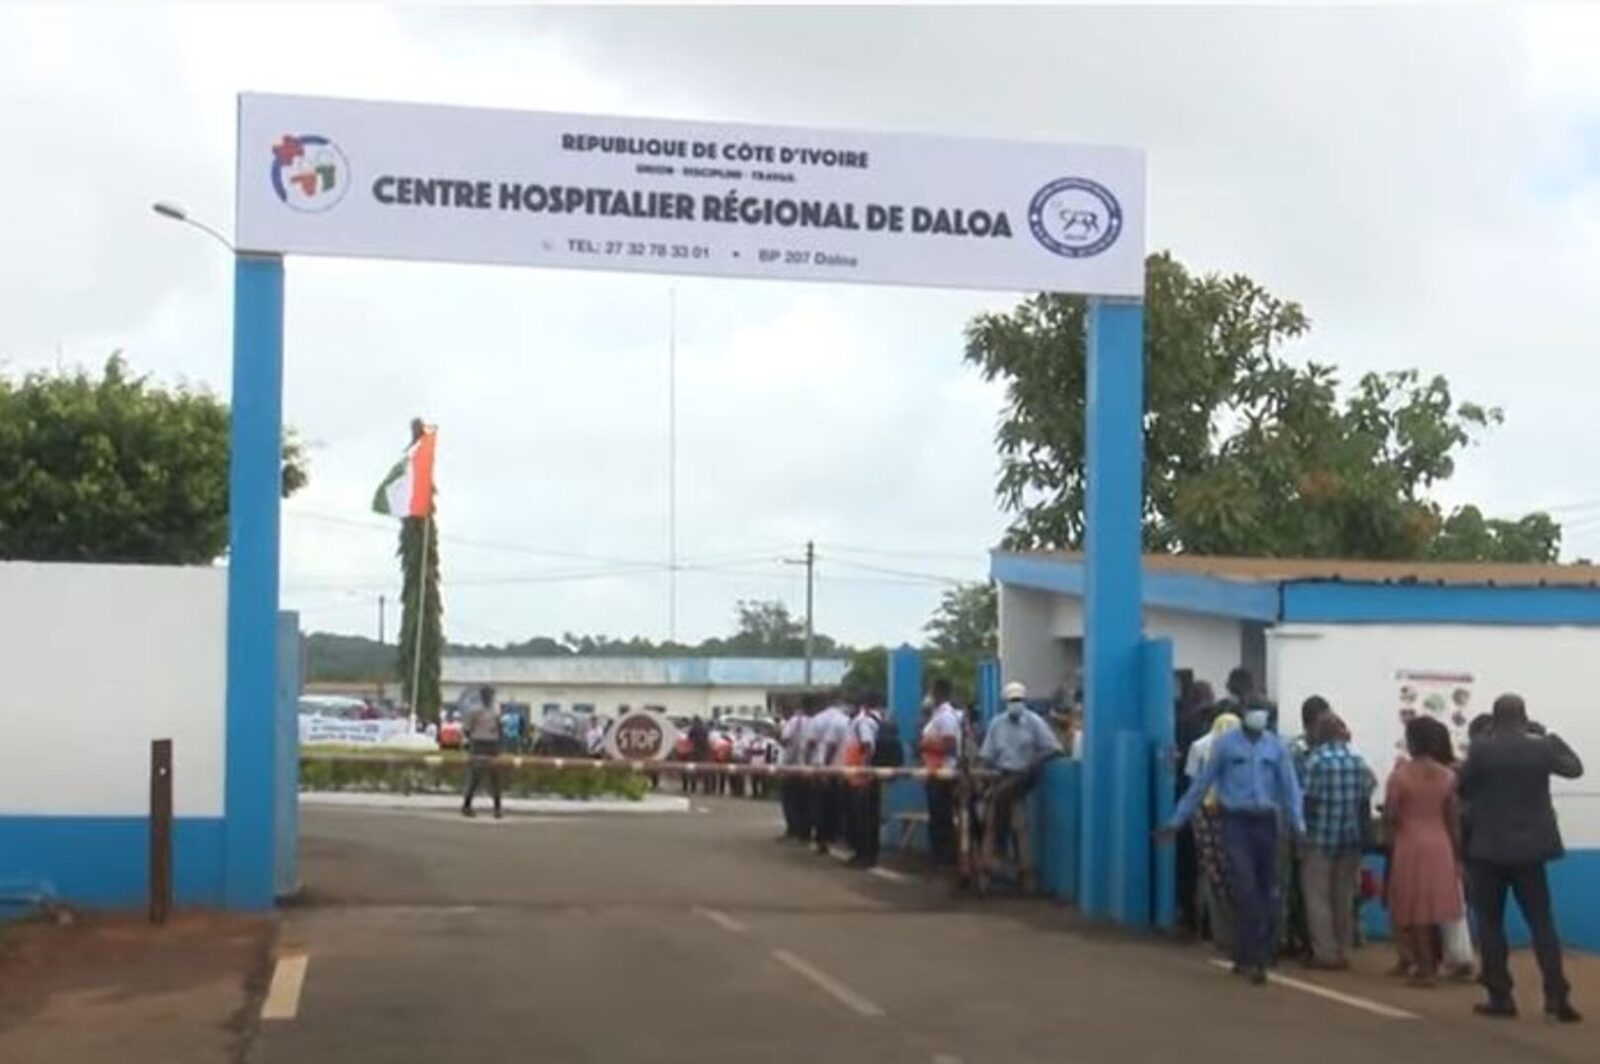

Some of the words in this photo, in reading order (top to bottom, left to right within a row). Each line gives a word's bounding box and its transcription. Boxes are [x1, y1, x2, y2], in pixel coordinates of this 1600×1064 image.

[562, 133, 686, 158] REPUBLIQUE
[692, 142, 717, 159] DE
[722, 142, 775, 163] CÔTE
[780, 147, 869, 169] D'IVOIRE
[372, 175, 492, 209] CENTRE
[499, 182, 696, 221] HOSPITALIER
[702, 189, 860, 230] RÉGIONAL
[866, 203, 905, 232] DE
[911, 206, 1013, 238] DALOA
[567, 238, 601, 254] TEL:
[620, 728, 660, 750] STOP
